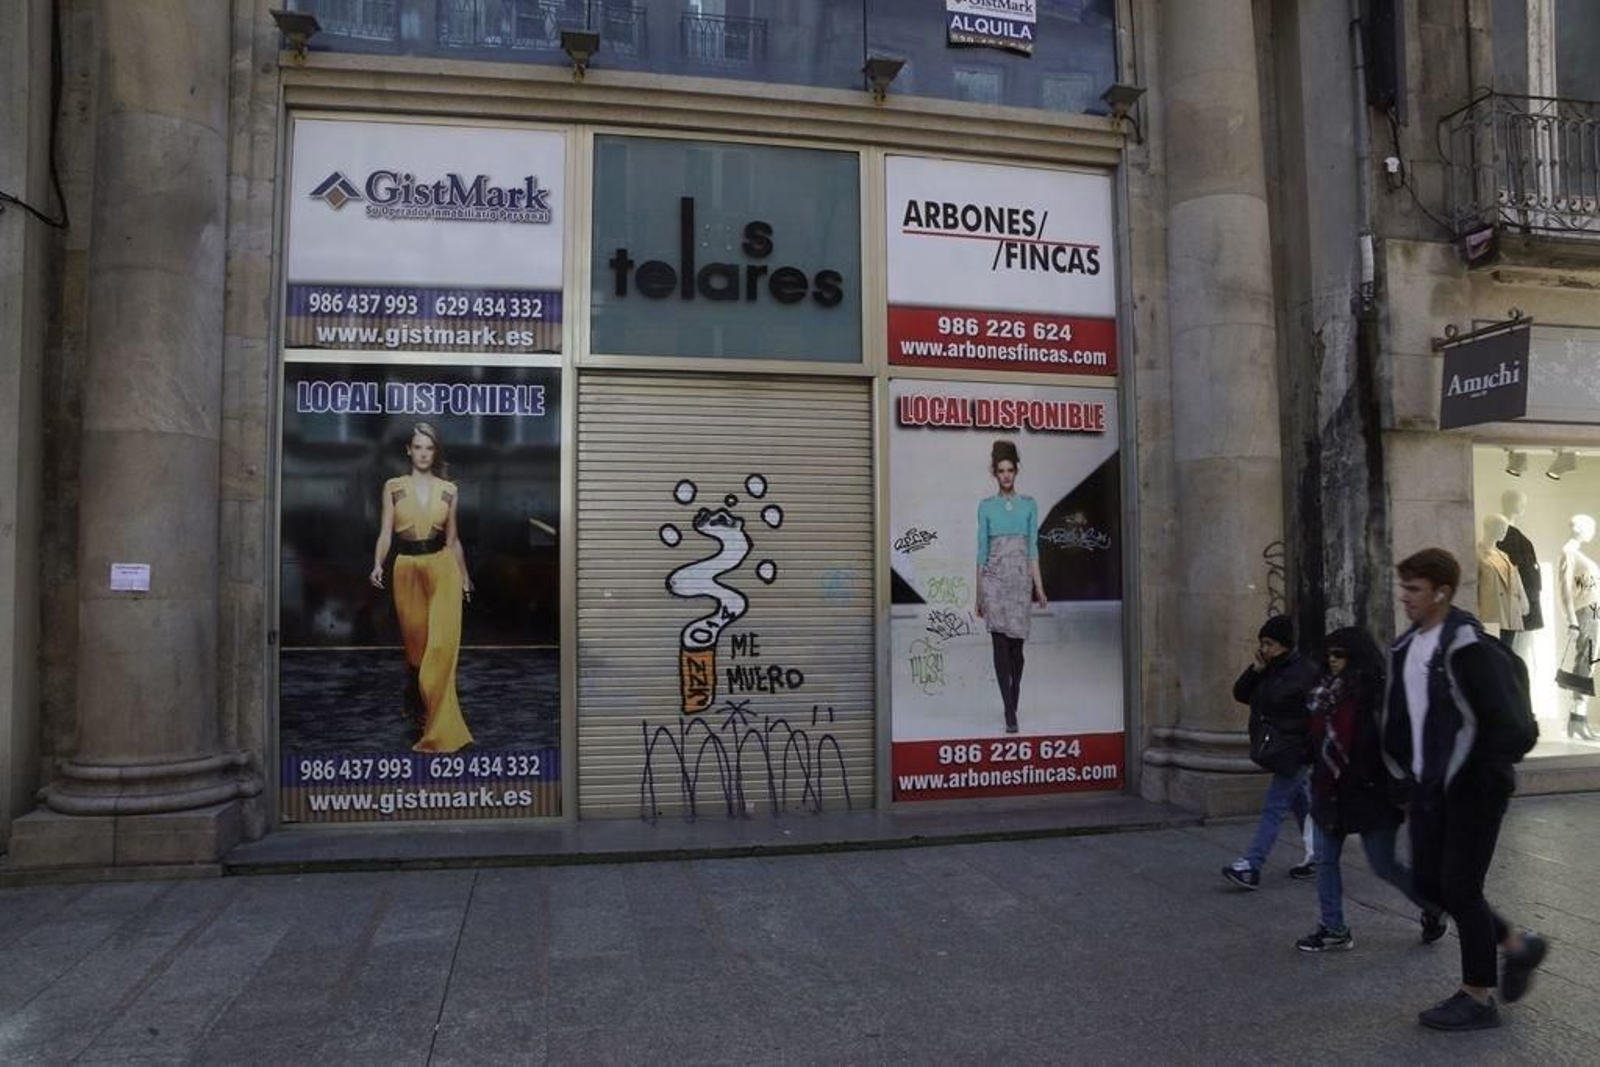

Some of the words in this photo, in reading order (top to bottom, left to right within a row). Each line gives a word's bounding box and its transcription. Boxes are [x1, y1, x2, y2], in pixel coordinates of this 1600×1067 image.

[951, 15, 1033, 40] ALQUILA
[365, 170, 549, 210] GistMark
[382, 206, 428, 217] Operador
[431, 208, 496, 220] Inmobiliario
[500, 210, 549, 222] Personal
[609, 196, 844, 309] telares
[309, 293, 343, 314] 986
[347, 294, 381, 315] 437
[385, 295, 418, 315] 993
[435, 296, 469, 317] 629
[472, 297, 507, 318] 434
[510, 298, 543, 319] 332
[316, 324, 534, 349] www.gistmark.es
[938, 316, 979, 336] 986
[986, 319, 1026, 339] 226
[1033, 322, 1072, 342] 624
[901, 340, 1107, 366] www.arbonesfincas.com
[1447, 360, 1521, 397] Amichi
[297, 381, 382, 414] LOCAL
[385, 382, 546, 416] DISPONIBLE
[900, 396, 972, 426] LOCAL
[976, 398, 1105, 430] DISPONIBLE
[730, 631, 761, 660] ME
[725, 664, 805, 694] MUERO
[938, 744, 982, 765] 986
[990, 741, 1032, 762] 226
[1040, 739, 1082, 760] 624
[300, 759, 336, 781] 986
[339, 758, 374, 780] 437
[378, 758, 413, 779] 993
[430, 757, 465, 778] 629
[468, 756, 503, 777] 434
[506, 755, 541, 776] 332
[899, 764, 1118, 791] www.arbonesfincas.com
[309, 786, 533, 814] www.gistmark.es
